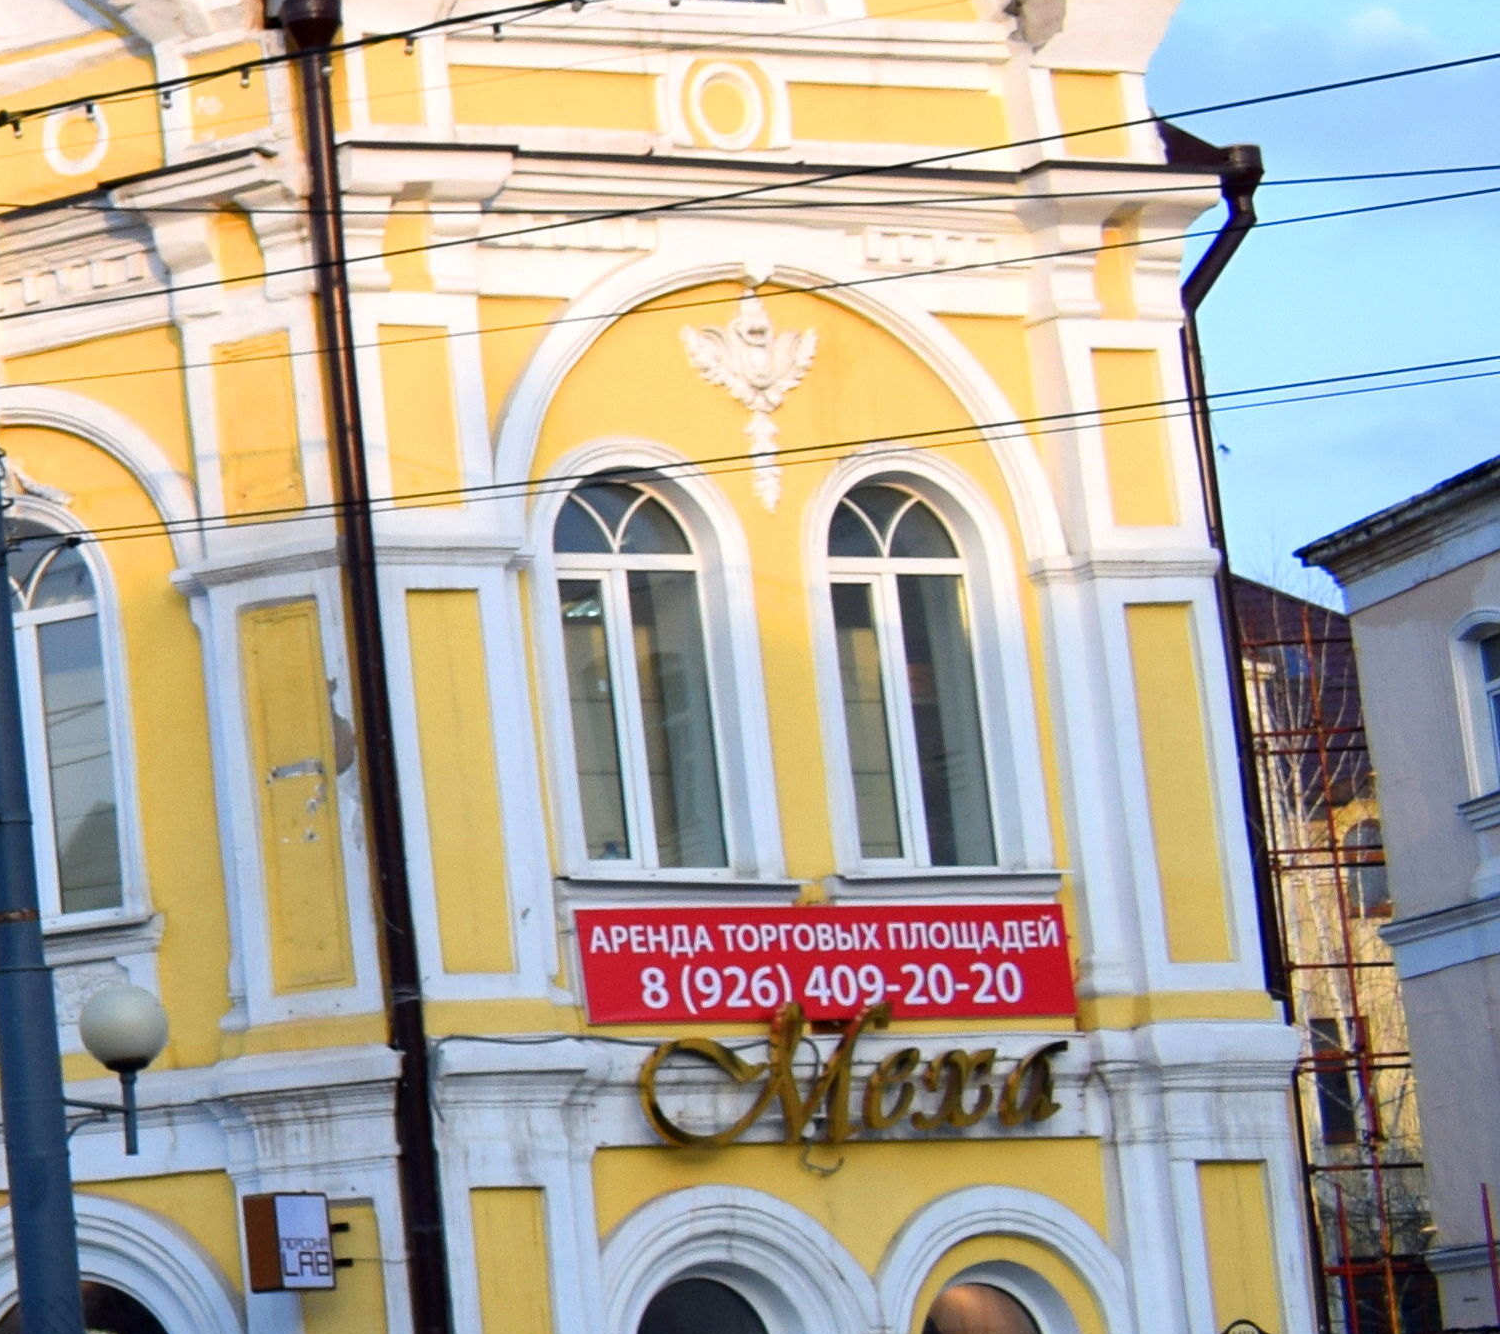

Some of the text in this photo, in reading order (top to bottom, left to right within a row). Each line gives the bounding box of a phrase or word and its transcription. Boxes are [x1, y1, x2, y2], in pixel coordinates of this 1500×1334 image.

[590, 915, 1060, 958] АРЕНДА ТОРГОВЫХ ПЛОЩАДЕЙ
[640, 962, 1024, 1014] 8 (926) 409-20-20
[638, 1001, 1069, 1147] Меха
[282, 1251, 332, 1276] LAB
